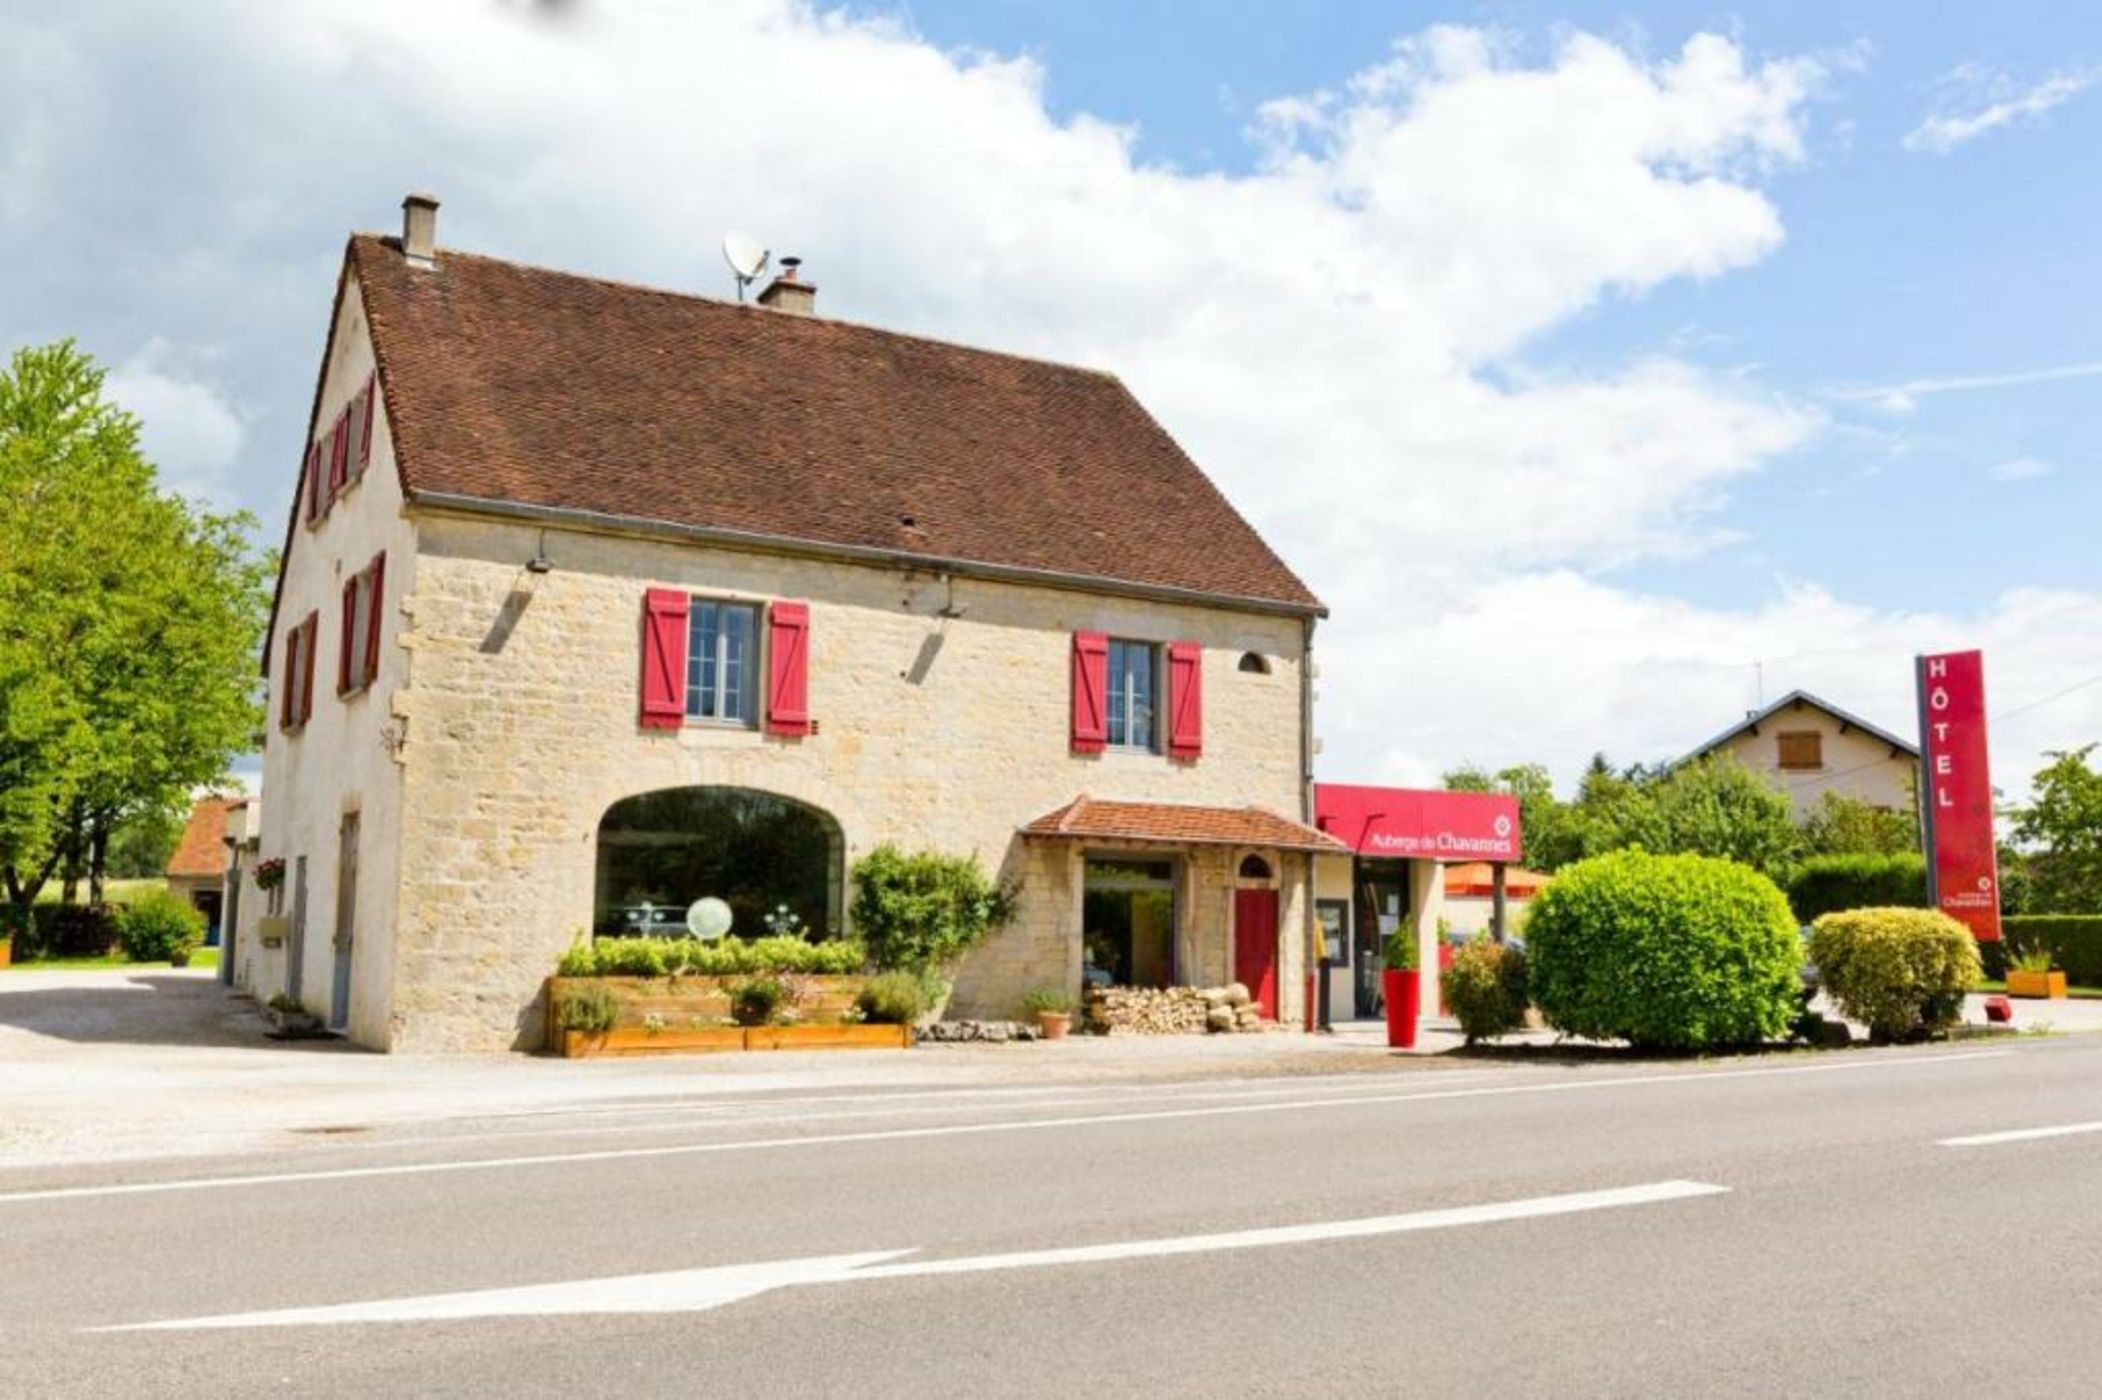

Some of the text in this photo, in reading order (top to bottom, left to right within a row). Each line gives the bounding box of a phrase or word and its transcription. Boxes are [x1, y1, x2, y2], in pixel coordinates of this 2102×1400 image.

[1930, 659, 1953, 806] HÔTEL
[1371, 833, 1420, 851] Auberge
[1437, 832, 1511, 852] Chavannes
